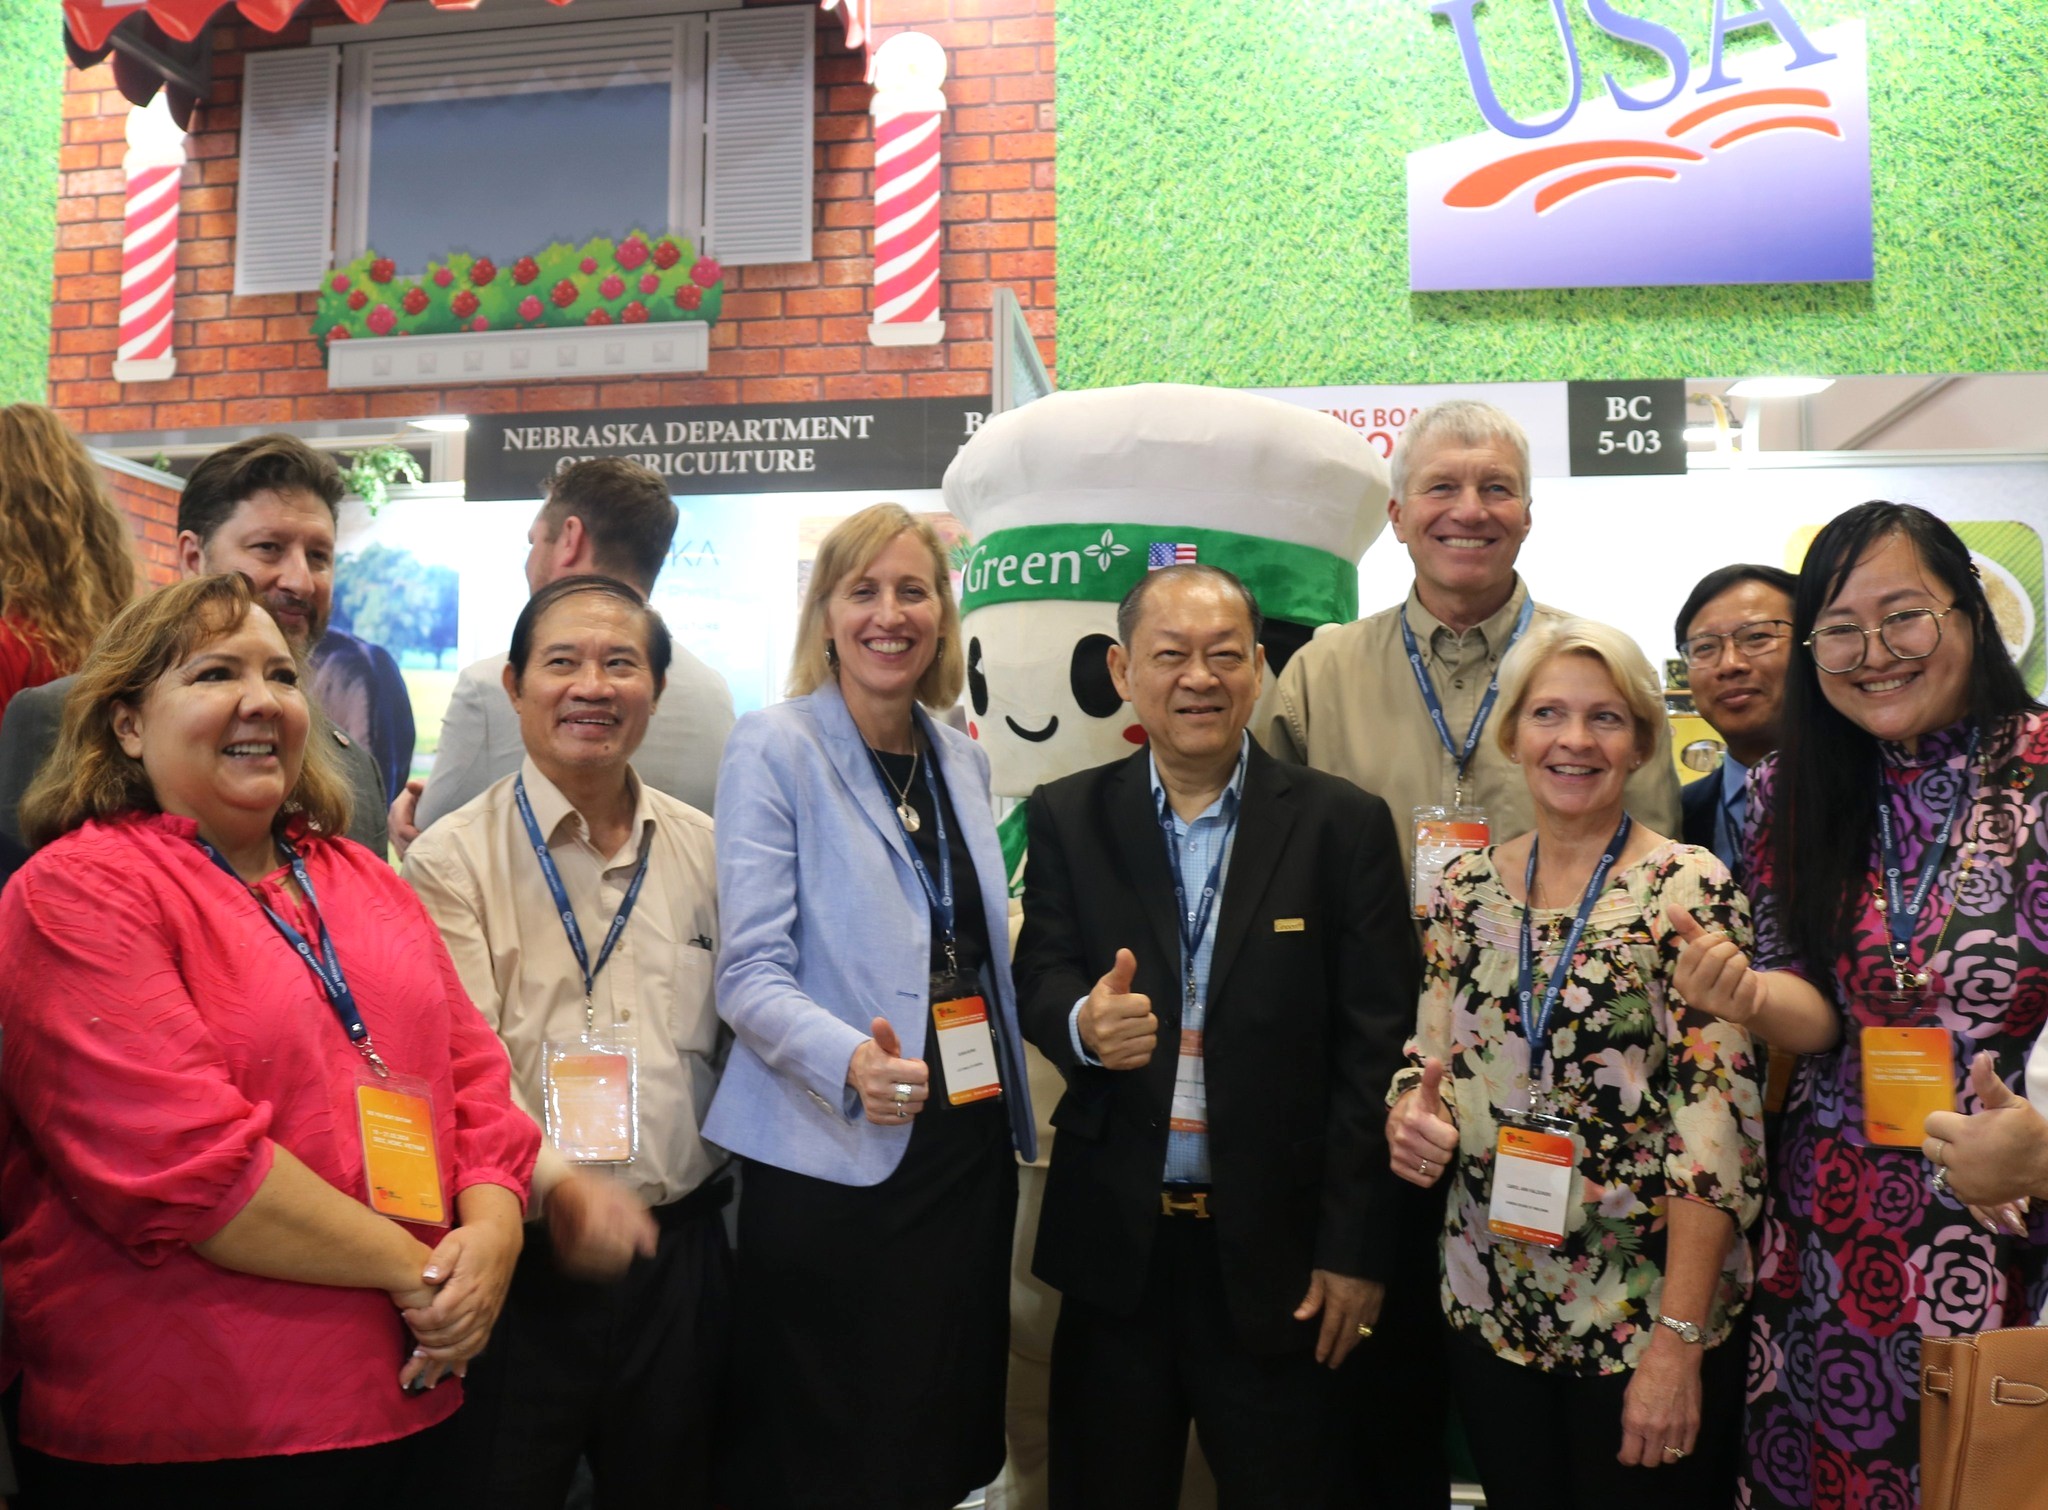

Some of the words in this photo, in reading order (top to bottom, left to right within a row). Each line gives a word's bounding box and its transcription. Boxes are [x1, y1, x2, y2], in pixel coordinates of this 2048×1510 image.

[1431, 0, 1837, 139] USA
[1318, 408, 1366, 428] NG
[1605, 395, 1653, 422] BC
[503, 422, 659, 451] NEBRASKA
[664, 414, 875, 446] DEPARTMENT
[964, 411, 993, 435] B
[1598, 429, 1662, 455] 5-03
[609, 447, 816, 477] RICULTURE
[965, 545, 1083, 594] Green
